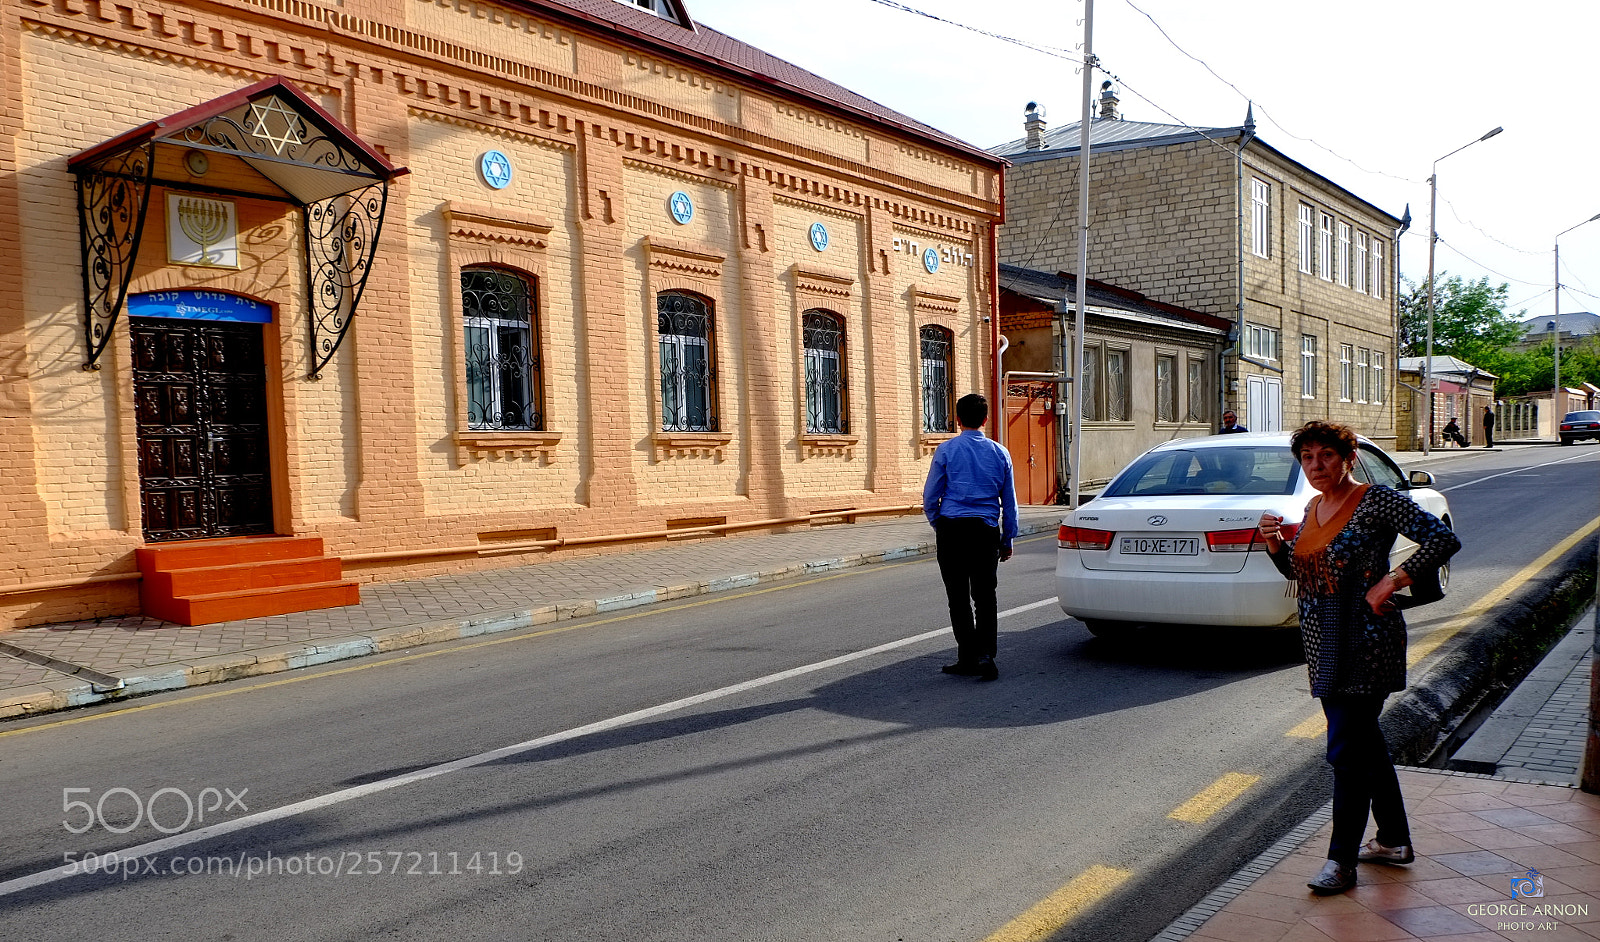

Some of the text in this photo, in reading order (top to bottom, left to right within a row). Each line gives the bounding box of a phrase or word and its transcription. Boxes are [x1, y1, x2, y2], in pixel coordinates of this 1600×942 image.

[148, 291, 257, 309] בית מדרש קובה
[1134, 539, 1194, 553] 10-XE-171
